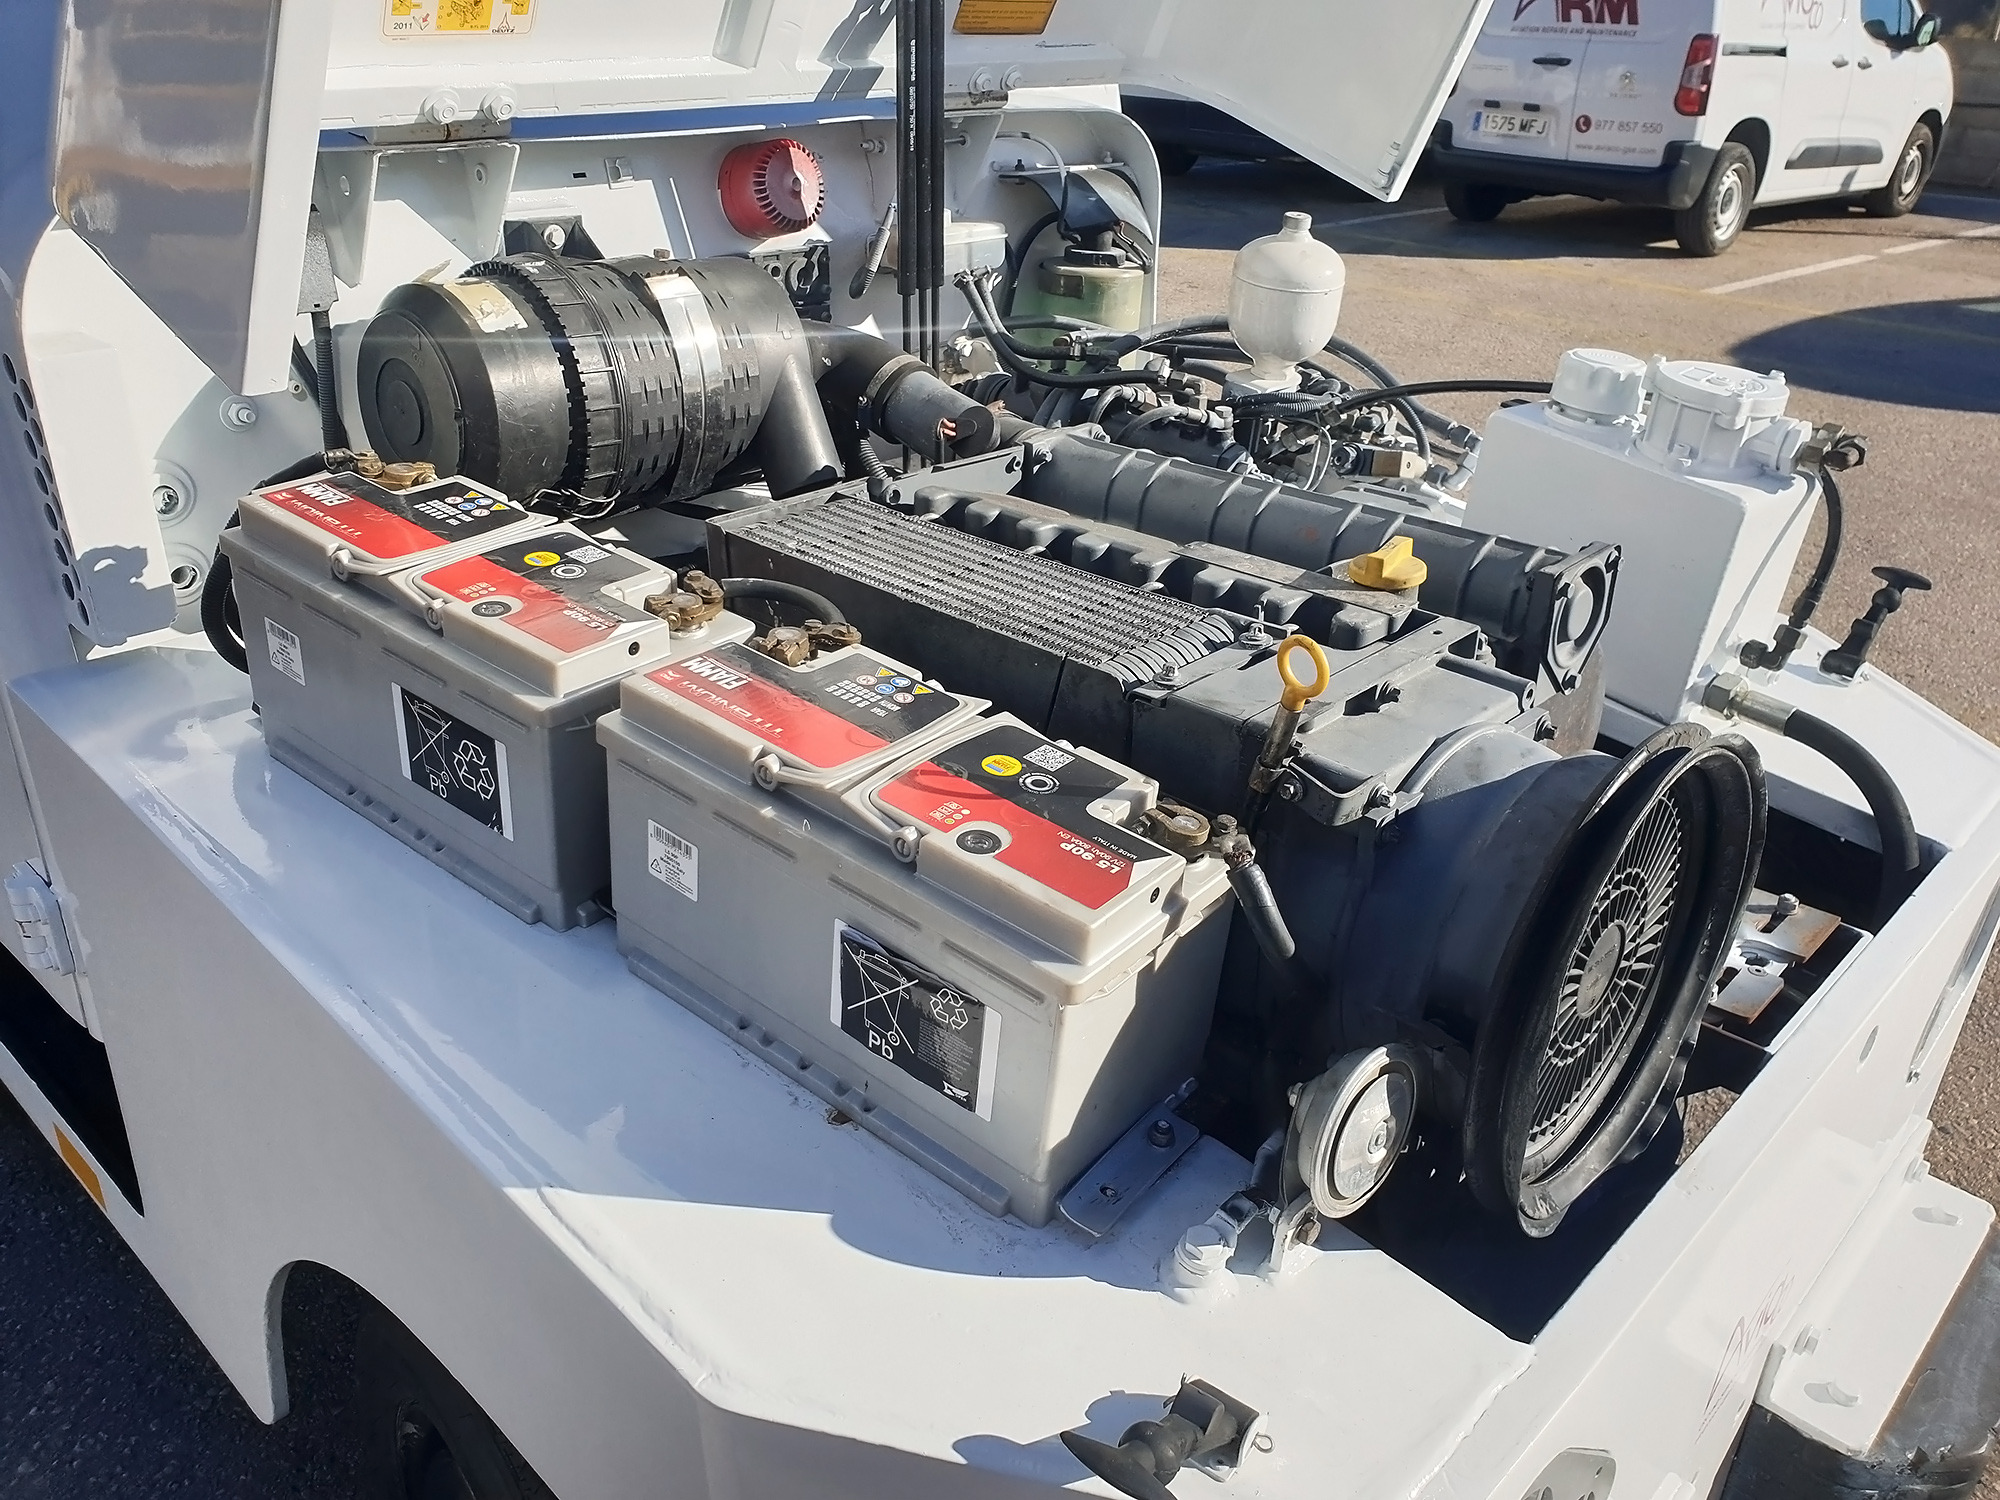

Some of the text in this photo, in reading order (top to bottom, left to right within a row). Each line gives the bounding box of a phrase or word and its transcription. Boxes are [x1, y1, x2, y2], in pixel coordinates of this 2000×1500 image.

[393, 22, 413, 30] 2011
[1485, 115, 1516, 131] 1575
[1595, 119, 1664, 134] 977 857 550
[296, 483, 350, 506] FIAMM
[562, 609, 609, 631] L5 90P
[681, 657, 749, 690] FIAMM
[678, 681, 783, 739] TITANIUM
[429, 773, 447, 798] Pb
[1057, 830, 1072, 840] EN
[1092, 835, 1111, 847] ITALY
[1059, 842, 1121, 874] L5 90P
[1111, 859, 1126, 868] 12V
[1118, 849, 1137, 860] MADE
[868, 1029, 894, 1060] Pb
